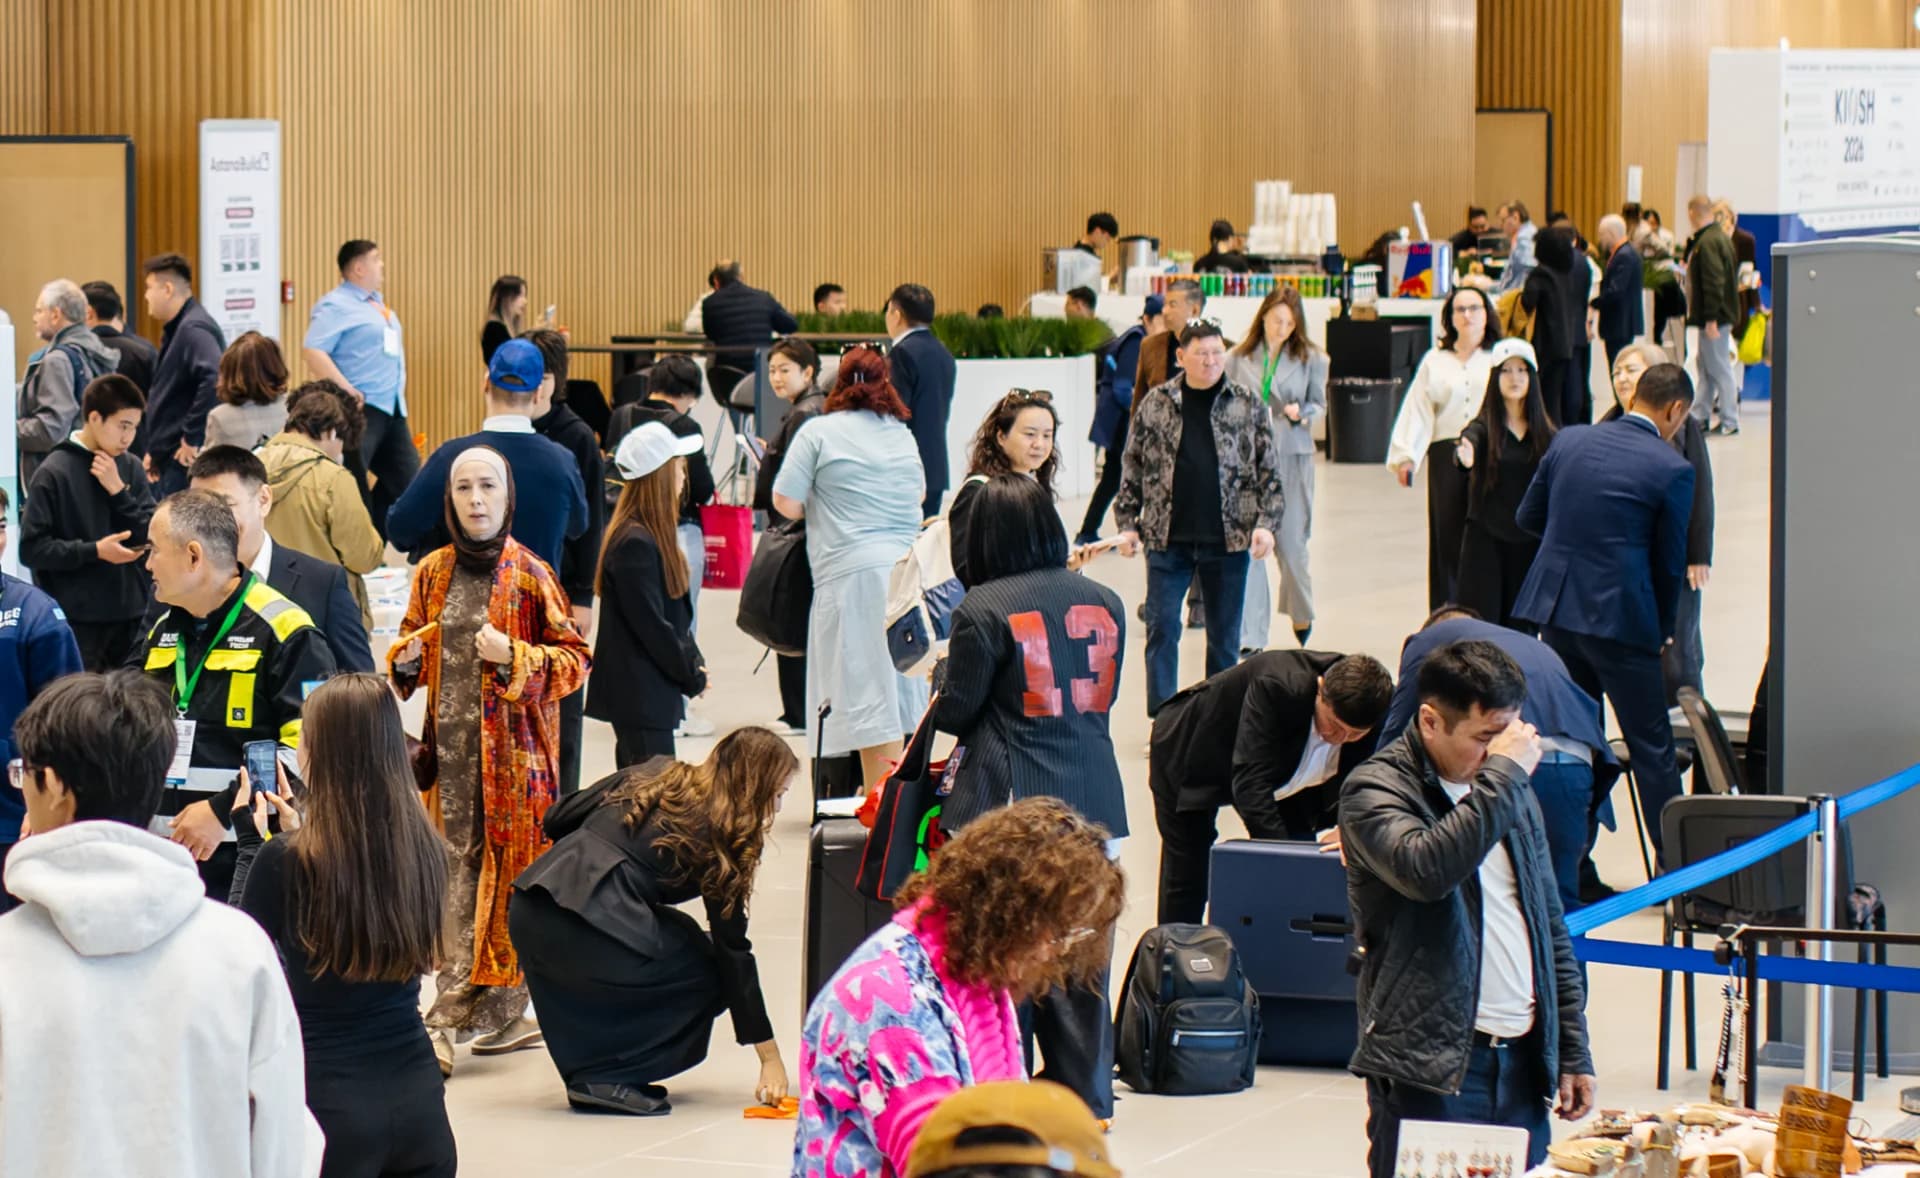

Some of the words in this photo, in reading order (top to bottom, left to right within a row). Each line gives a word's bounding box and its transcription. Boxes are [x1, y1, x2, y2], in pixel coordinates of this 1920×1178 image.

[1391, 244, 1410, 255] Red
[1411, 244, 1431, 255] Bull
[1007, 604, 1119, 717] 13
